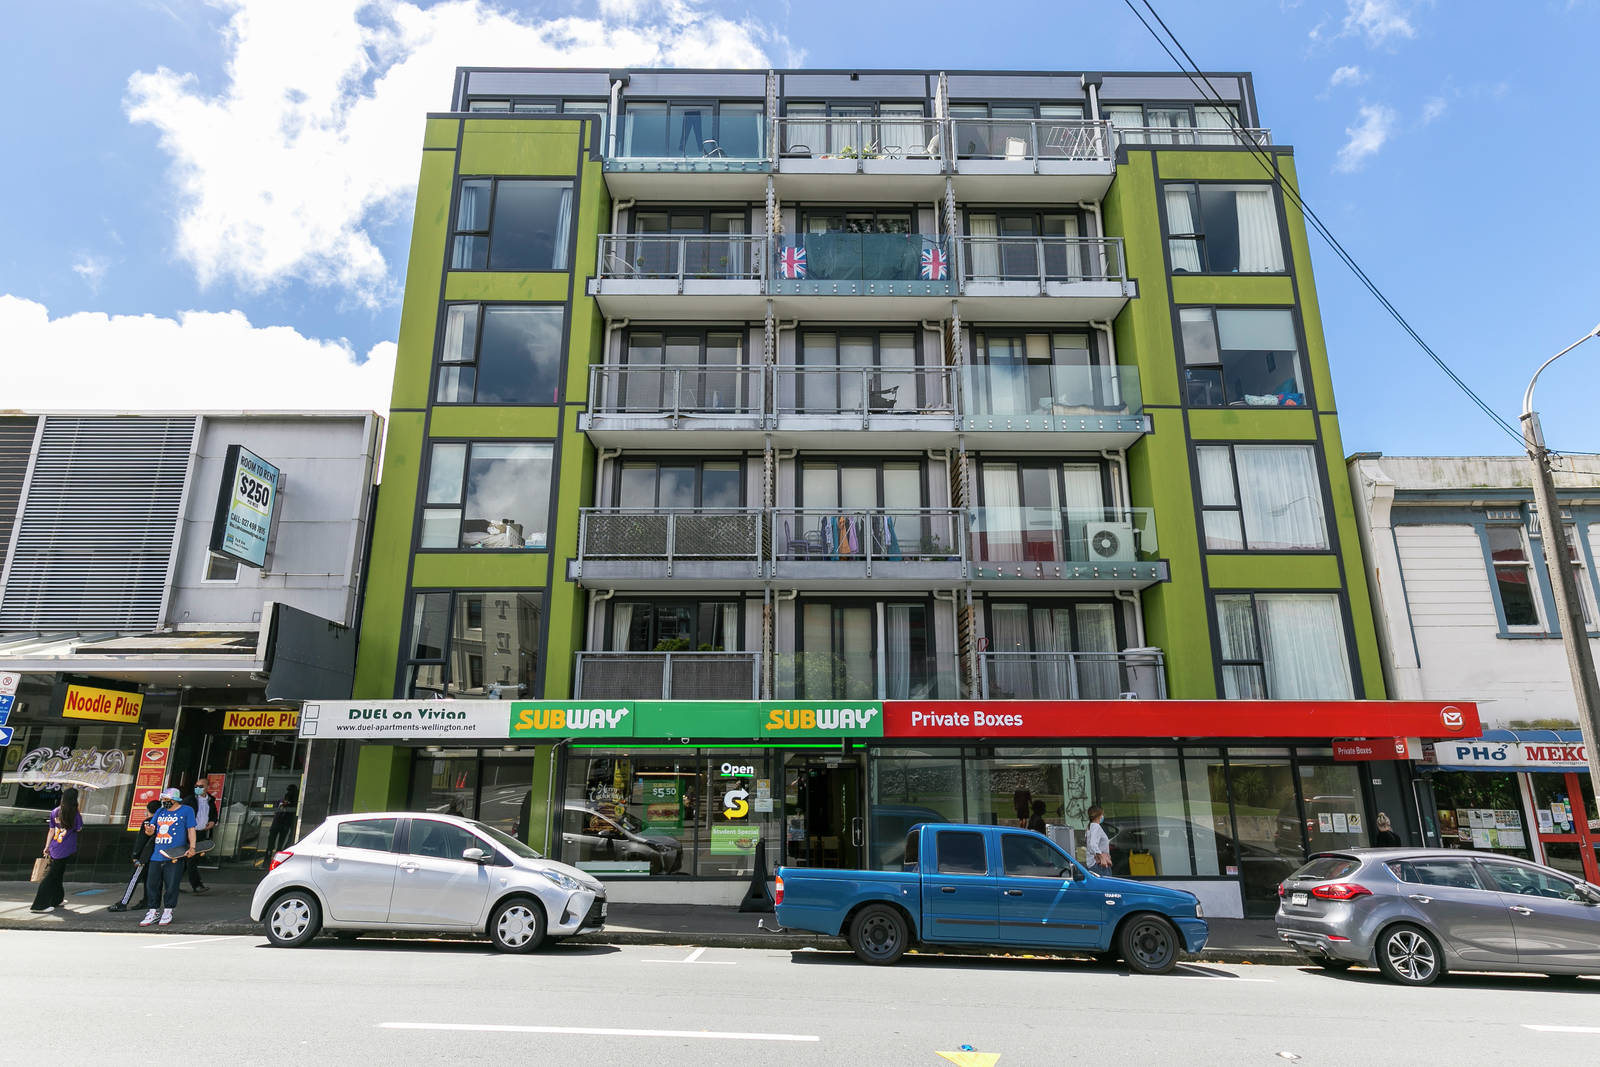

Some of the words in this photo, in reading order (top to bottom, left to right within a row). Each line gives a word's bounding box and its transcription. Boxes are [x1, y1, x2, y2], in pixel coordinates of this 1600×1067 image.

[241, 455, 256, 473] ROOM
[256, 465, 263, 477] TO
[263, 469, 276, 483] RENT
[240, 474, 270, 507] $250
[67, 690, 112, 714] Noodle
[114, 694, 140, 717] Plus
[229, 713, 275, 728] Noodle
[279, 713, 298, 728] Plu
[349, 708, 388, 720] DUEL
[392, 711, 412, 720] on
[418, 708, 466, 720] Vivian
[514, 707, 629, 731] SUBWAY
[765, 707, 878, 731] SUBWAY
[911, 711, 970, 727] Private
[973, 711, 1023, 727] Boxes
[336, 724, 476, 732] www.duel-apartments-wellington.net
[1338, 747, 1355, 755] Private
[1356, 746, 1373, 755] Boxes
[721, 762, 754, 777] Open
